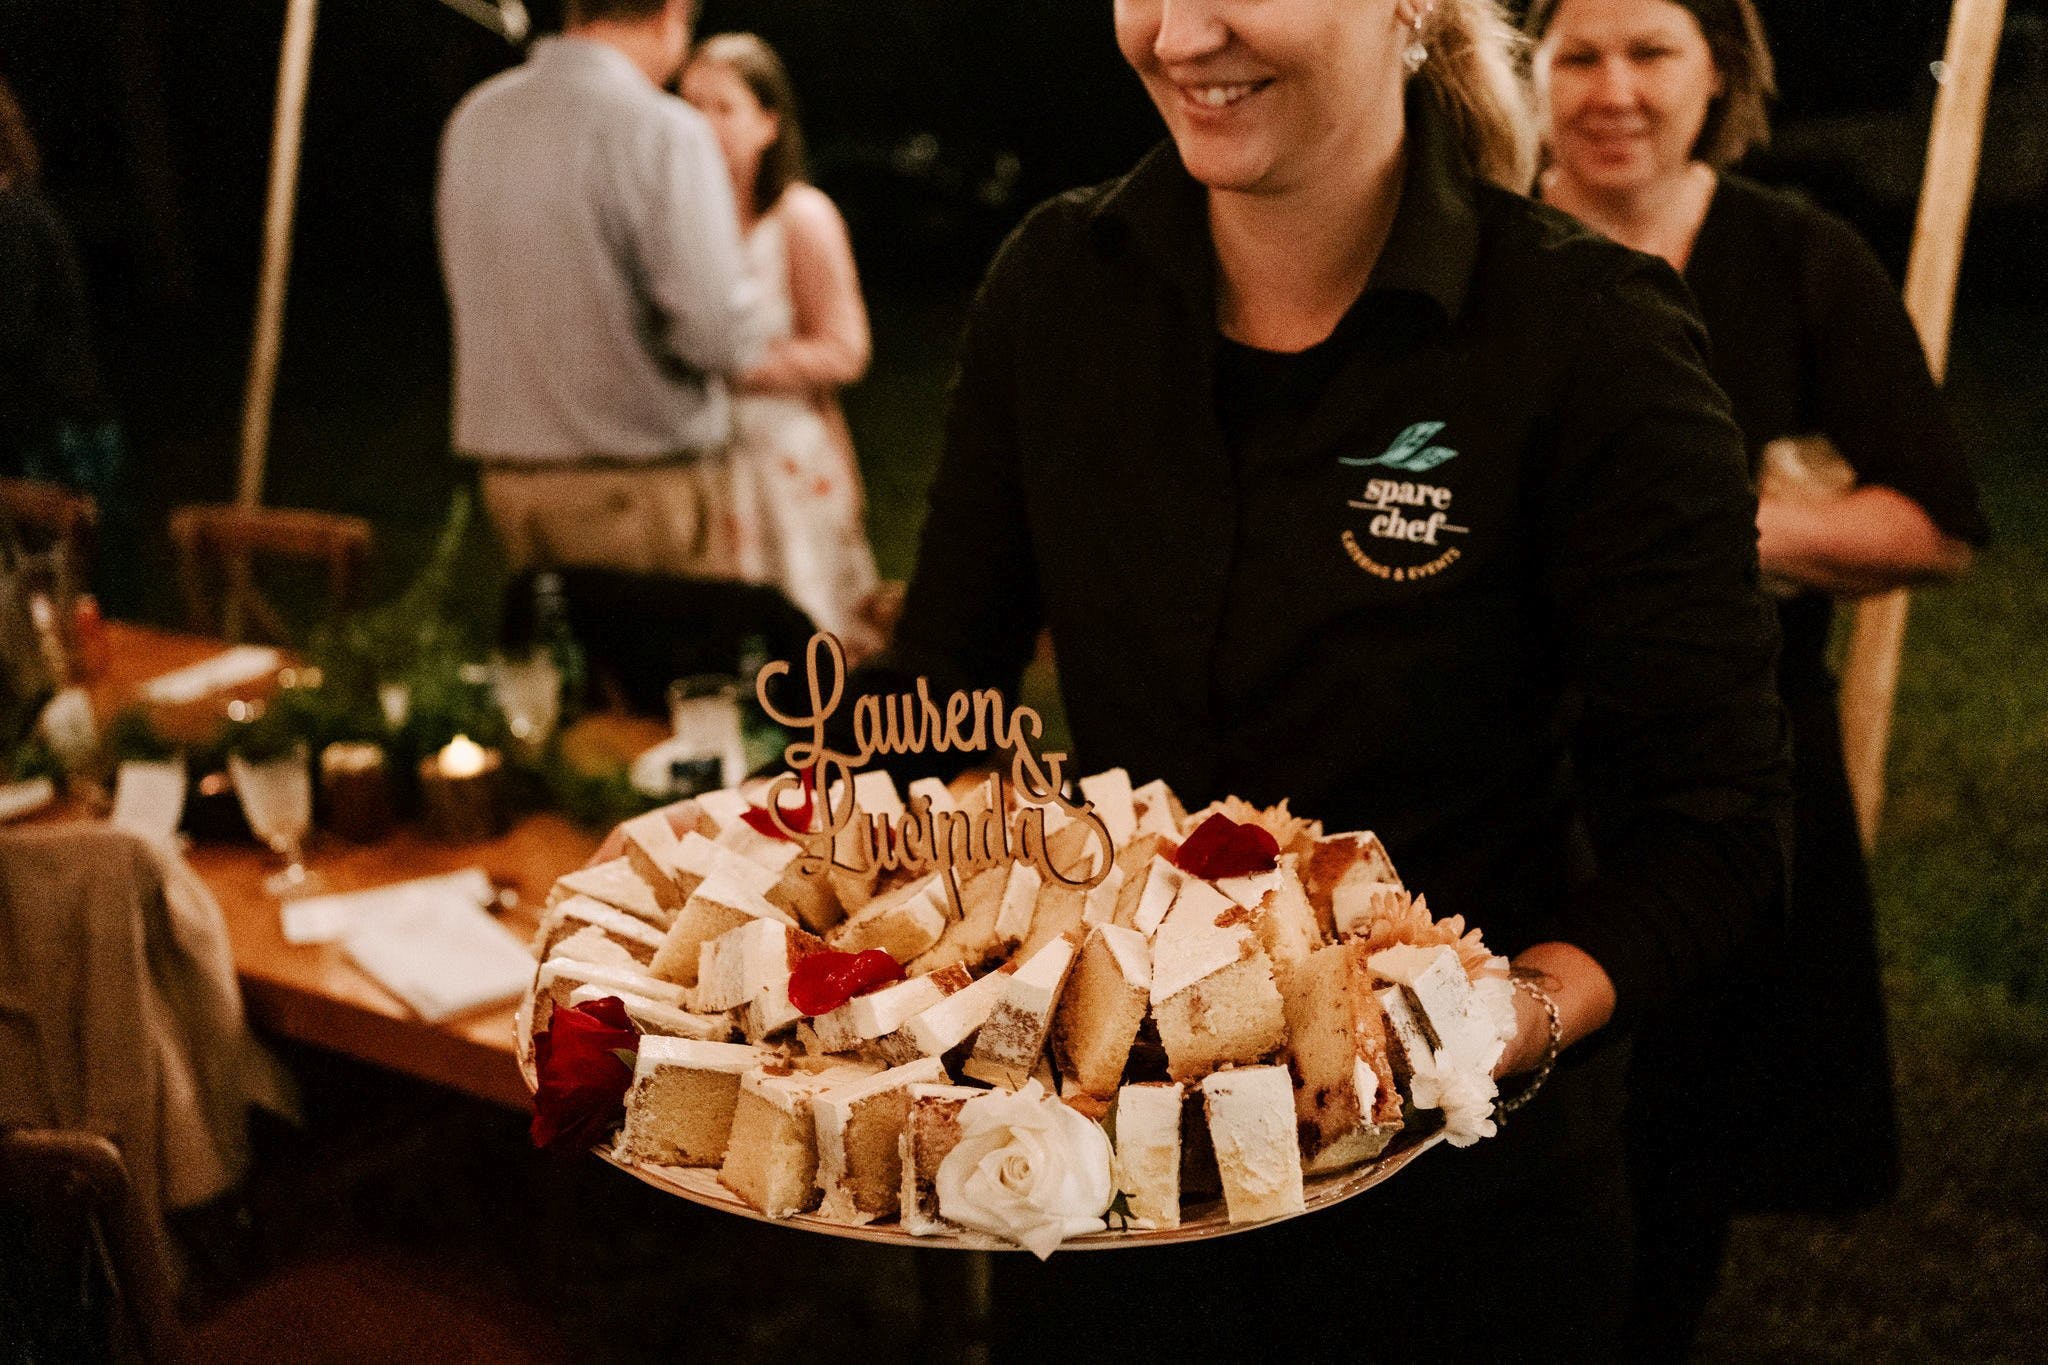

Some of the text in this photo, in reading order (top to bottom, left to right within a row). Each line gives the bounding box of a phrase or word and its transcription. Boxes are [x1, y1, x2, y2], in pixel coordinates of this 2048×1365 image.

[1364, 478, 1453, 510] spare
[1369, 507, 1449, 546] chef
[756, 631, 1080, 811] Lauren &
[768, 754, 1114, 890] Lucinda
